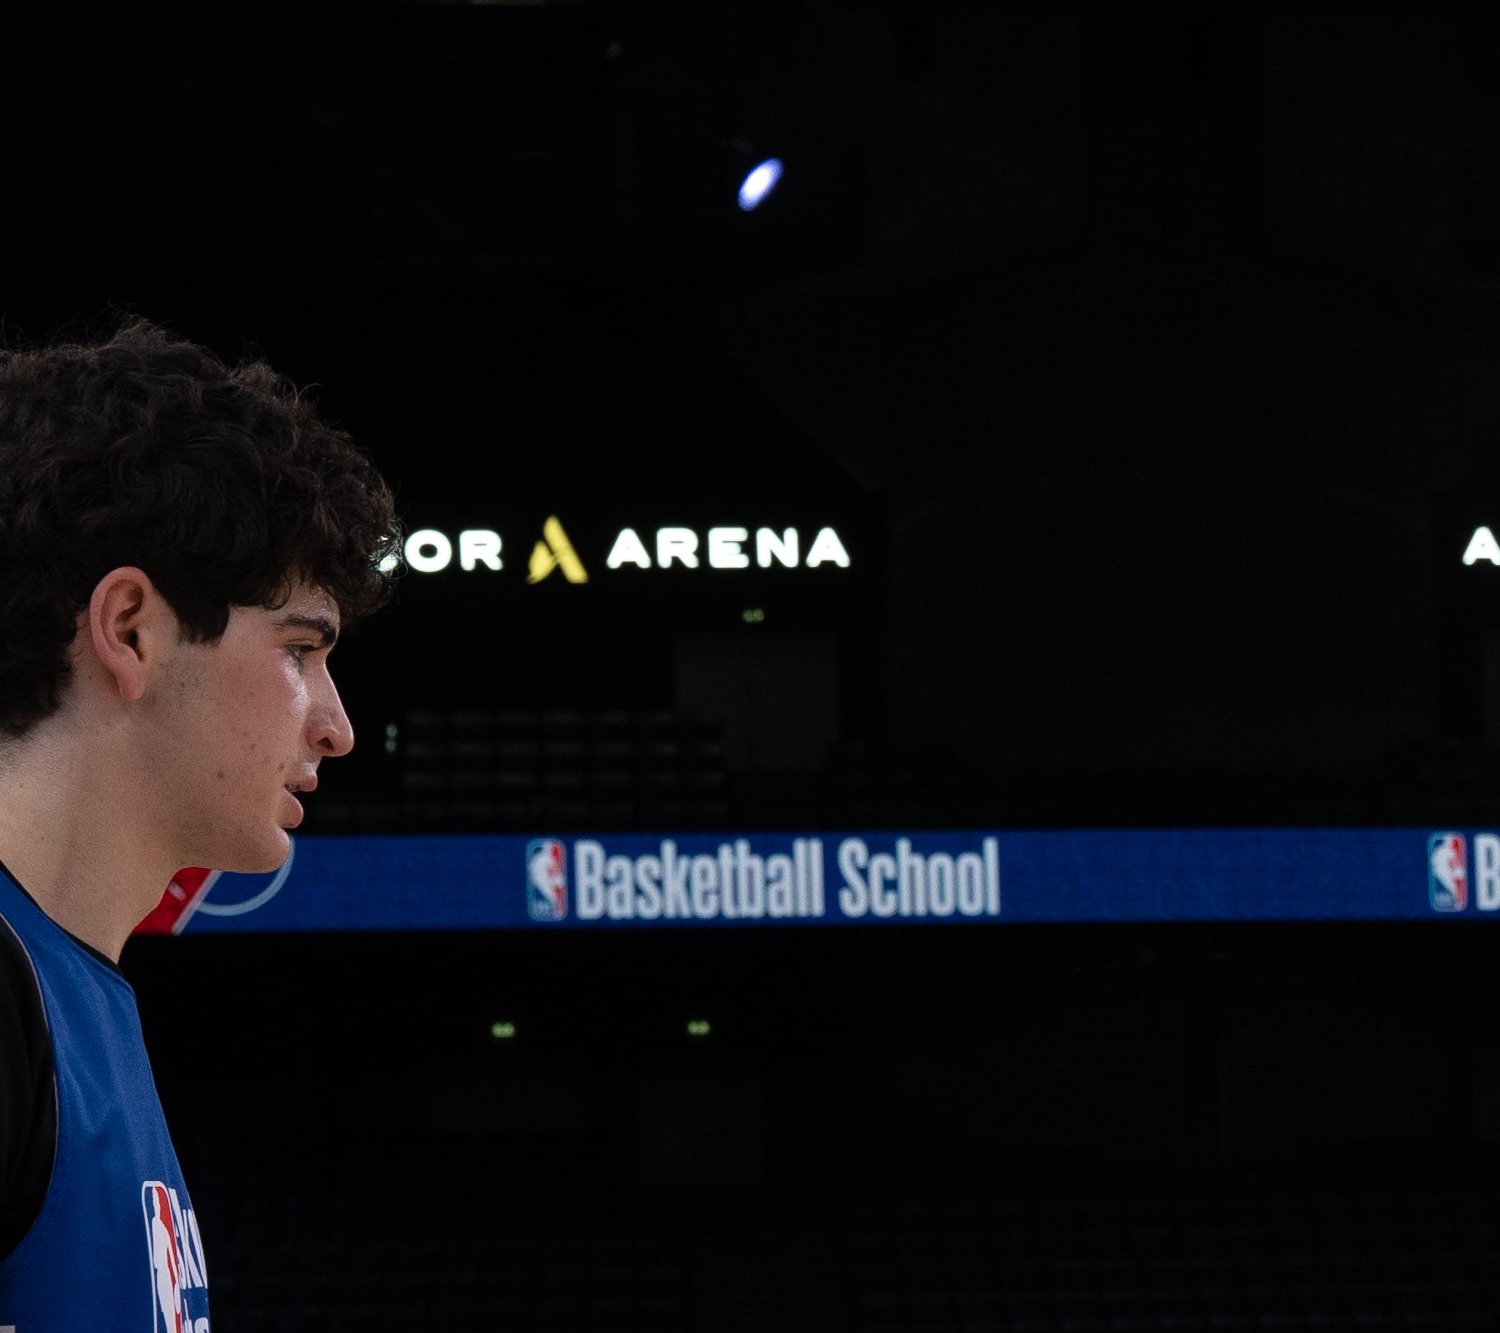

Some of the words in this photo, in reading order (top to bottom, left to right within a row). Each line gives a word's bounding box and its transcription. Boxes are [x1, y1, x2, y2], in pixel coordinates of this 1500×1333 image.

[605, 526, 851, 570] ARENA
[574, 838, 826, 919] Basketball
[838, 837, 1001, 917] School
